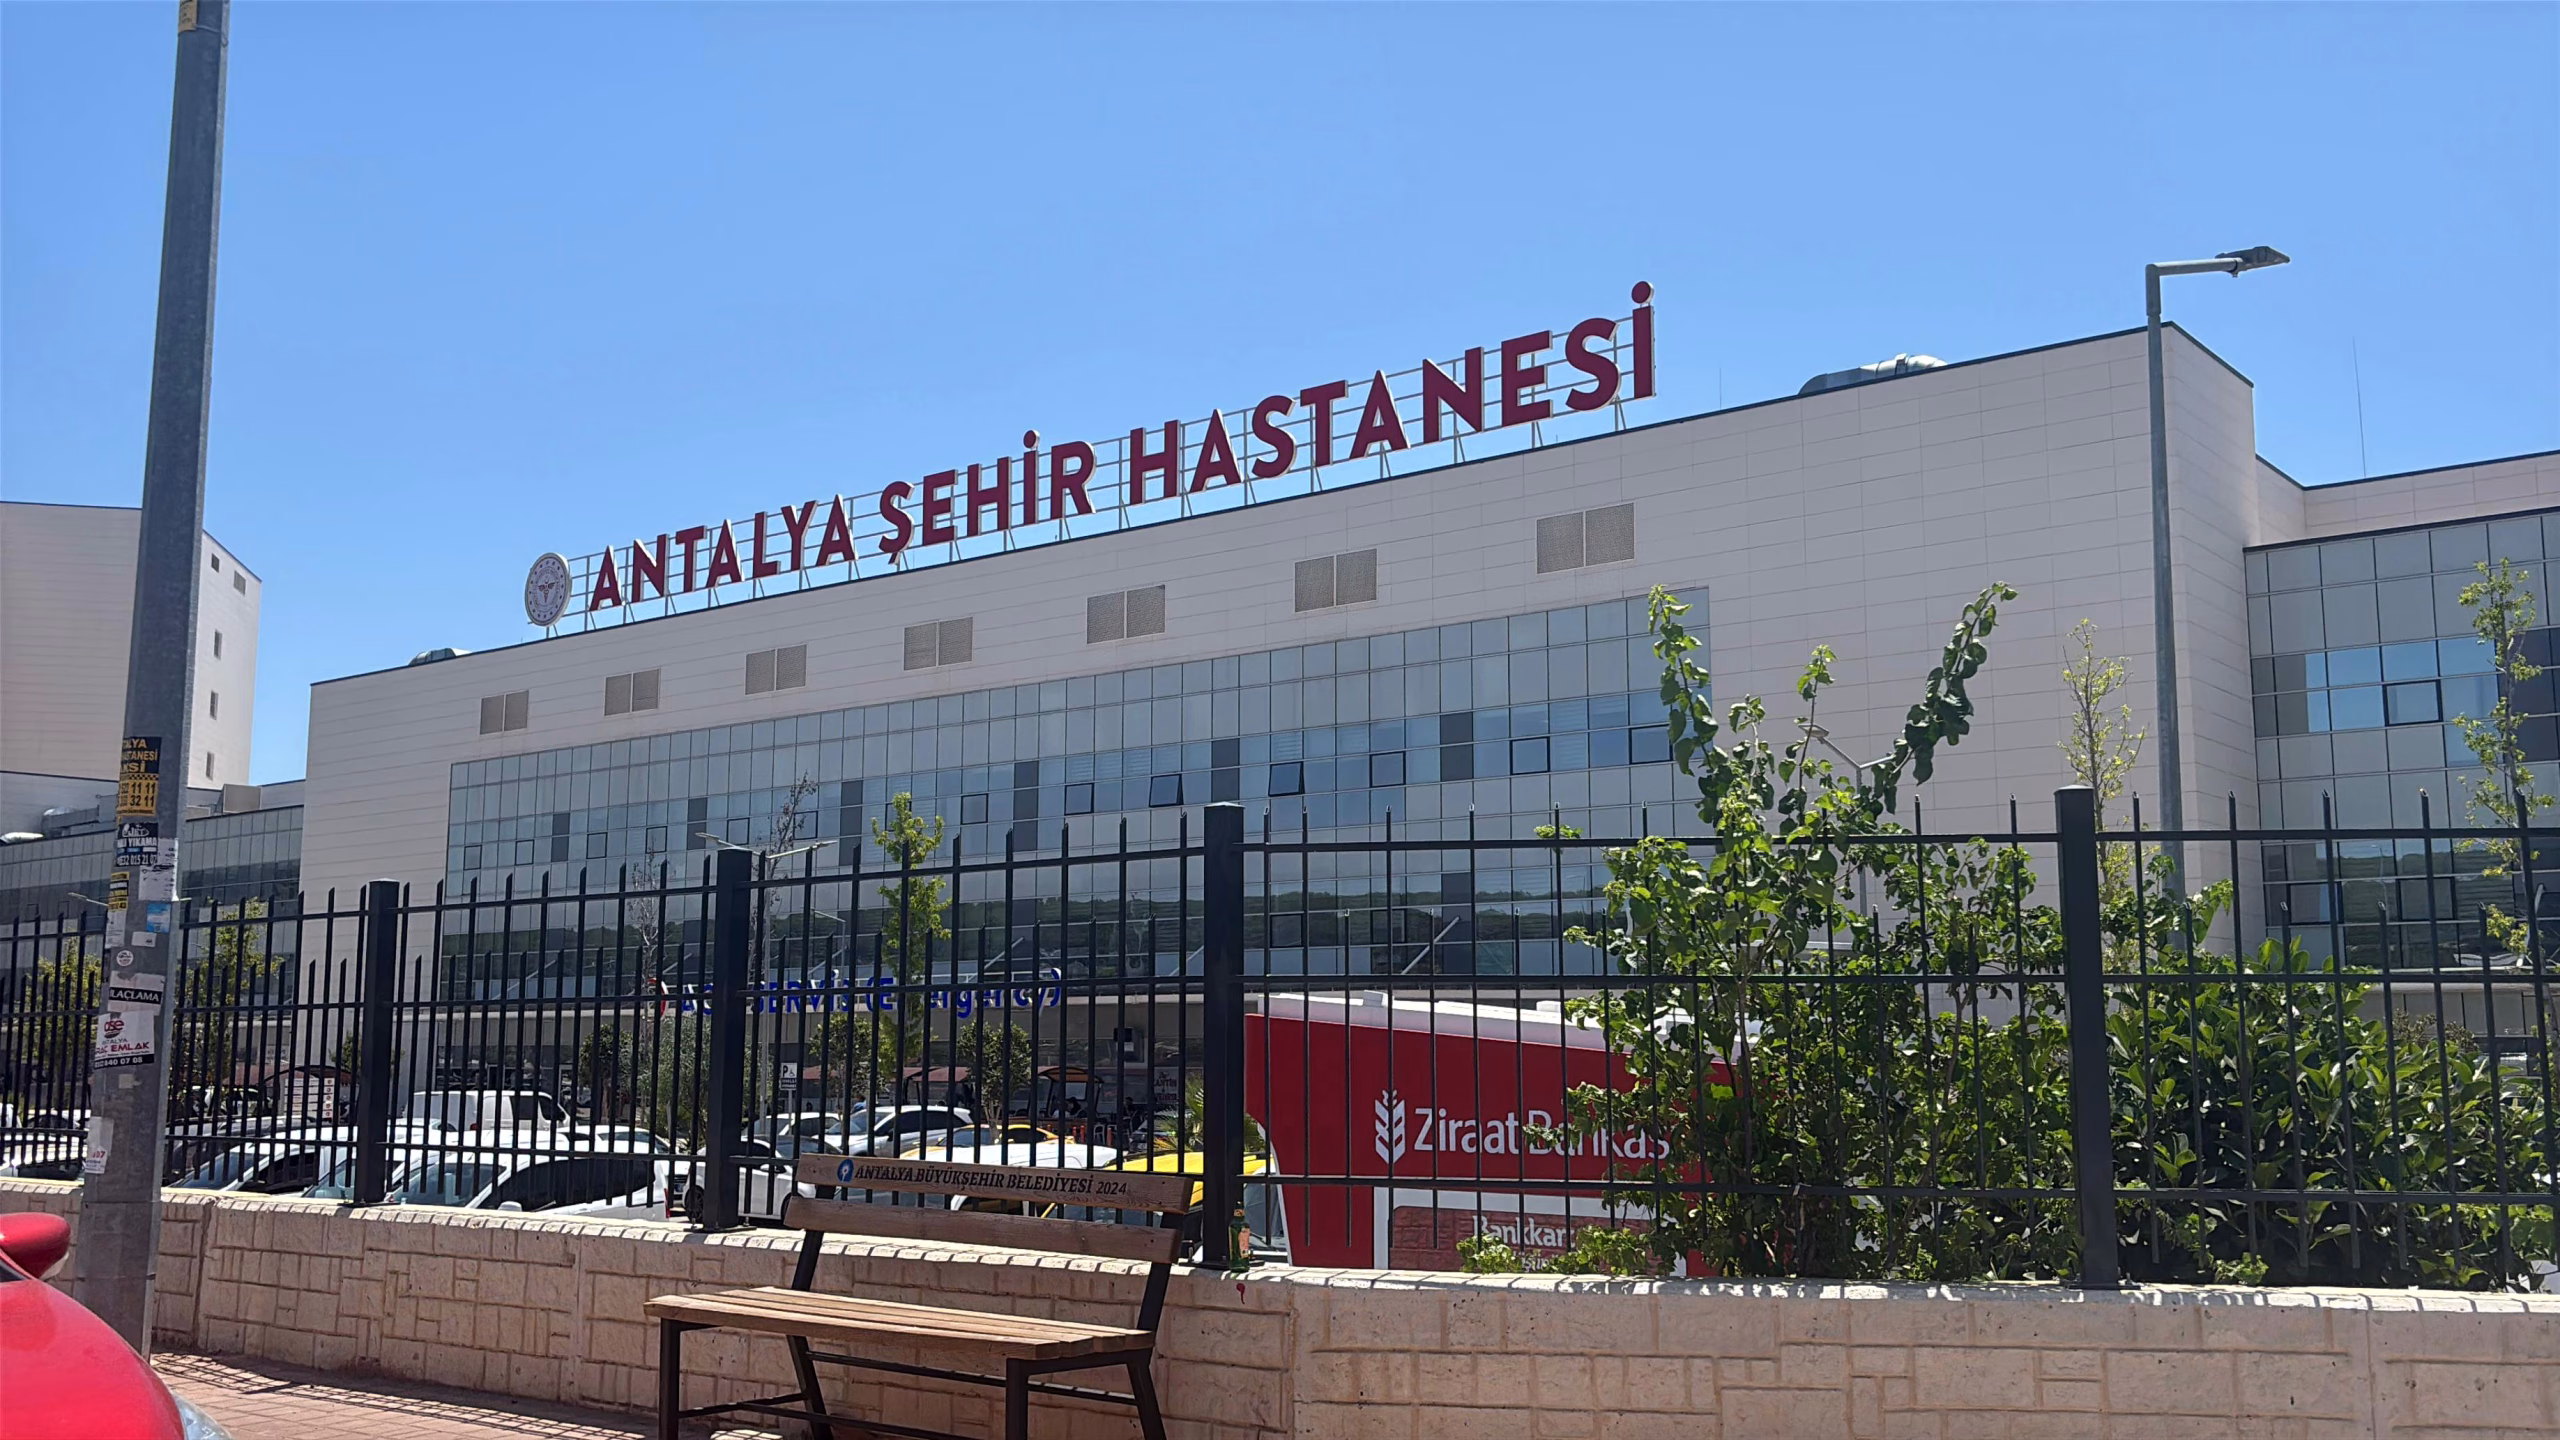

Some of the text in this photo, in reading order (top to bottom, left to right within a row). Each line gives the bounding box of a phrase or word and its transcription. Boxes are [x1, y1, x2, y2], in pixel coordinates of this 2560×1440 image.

[589, 281, 1655, 611] ANTALYA ŞEHİR HASTANESİ
[111, 1042, 150, 1052] EMLAK
[1414, 1107, 1671, 1160] Ziraat Bankas
[855, 1164, 1127, 1195] ANTALYA BÜYÜKŞEHİR BELEDİYESİ 2024
